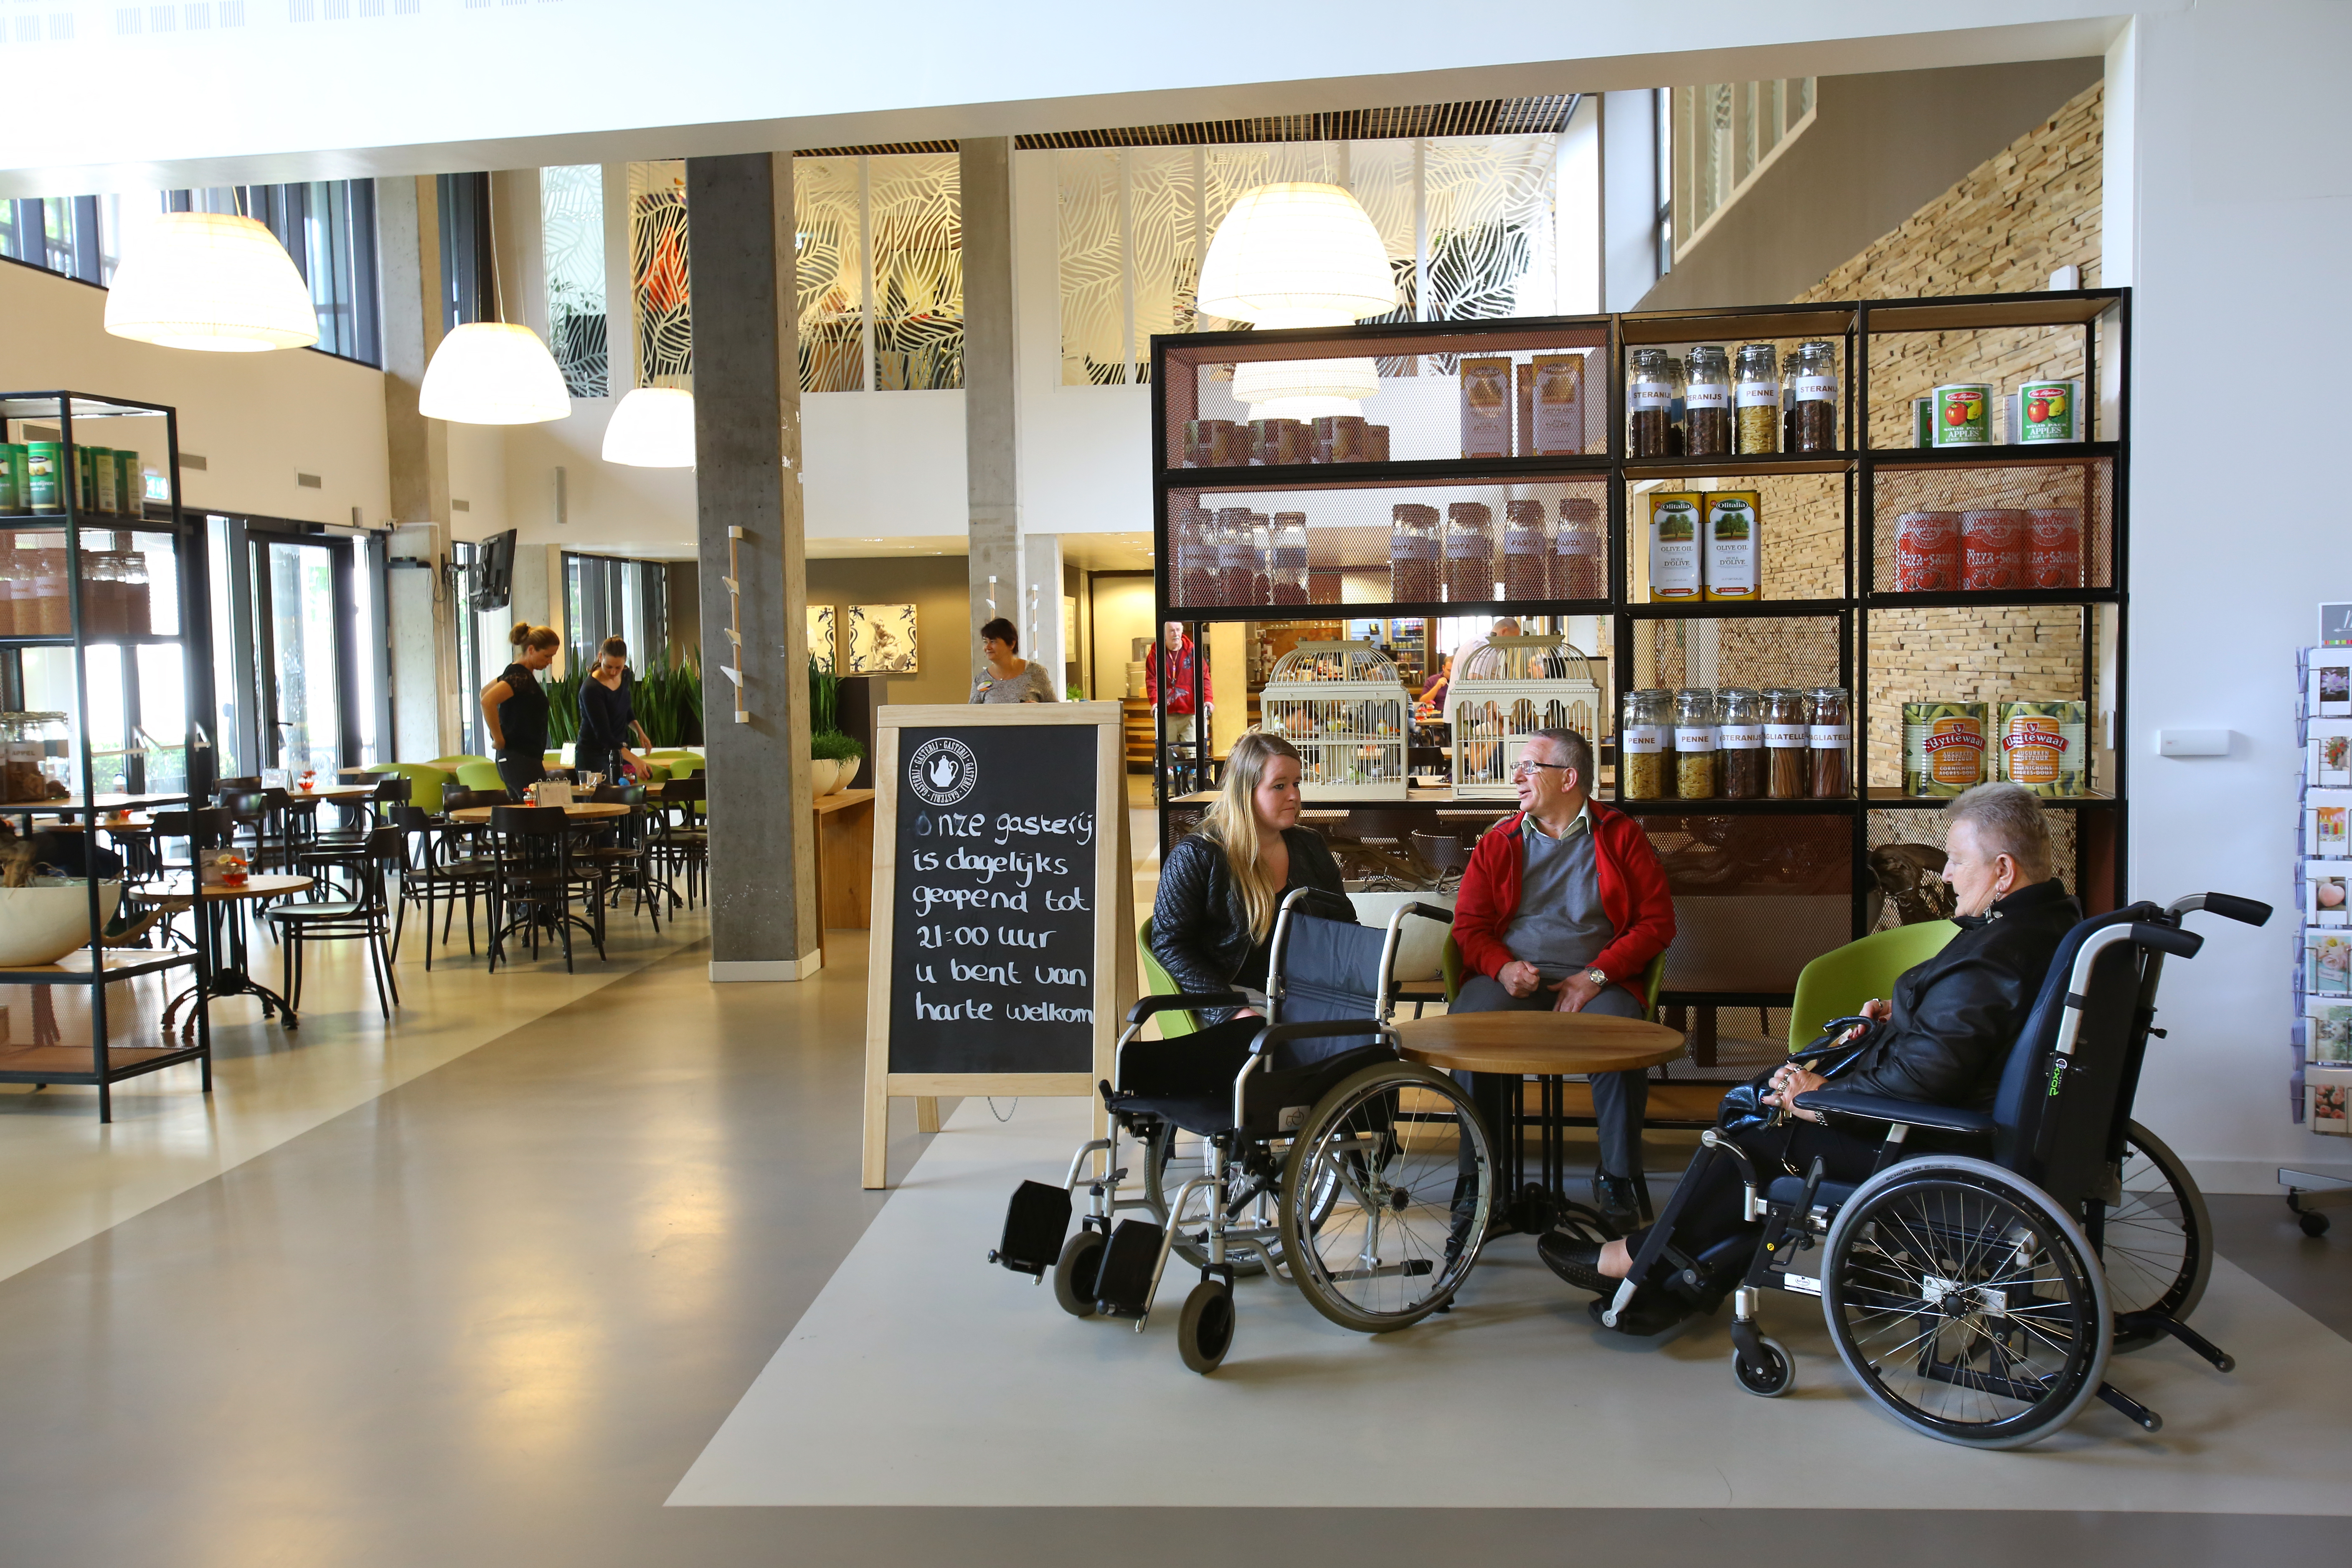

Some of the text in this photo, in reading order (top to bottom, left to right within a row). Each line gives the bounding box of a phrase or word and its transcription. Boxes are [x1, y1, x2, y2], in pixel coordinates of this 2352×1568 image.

[2030, 427, 2062, 435] APPLES
[914, 741, 939, 765] GASTERIJ
[944, 740, 970, 760] GASTERIJ
[1929, 735, 1983, 748] Uyttewaal
[912, 769, 929, 797] GASTERIJ
[960, 762, 974, 792] GASTERIJ
[930, 790, 960, 803] GASTERIJ
[994, 812, 1093, 845] gasterij
[912, 846, 1068, 888] is dagelijks
[913, 885, 1090, 917] geopend tot
[917, 925, 1056, 949] 21:00 uur
[916, 958, 1086, 987] u bent van
[916, 991, 1093, 1024] harte welkom
[1885, 1166, 1922, 1181] SCHWALBE
